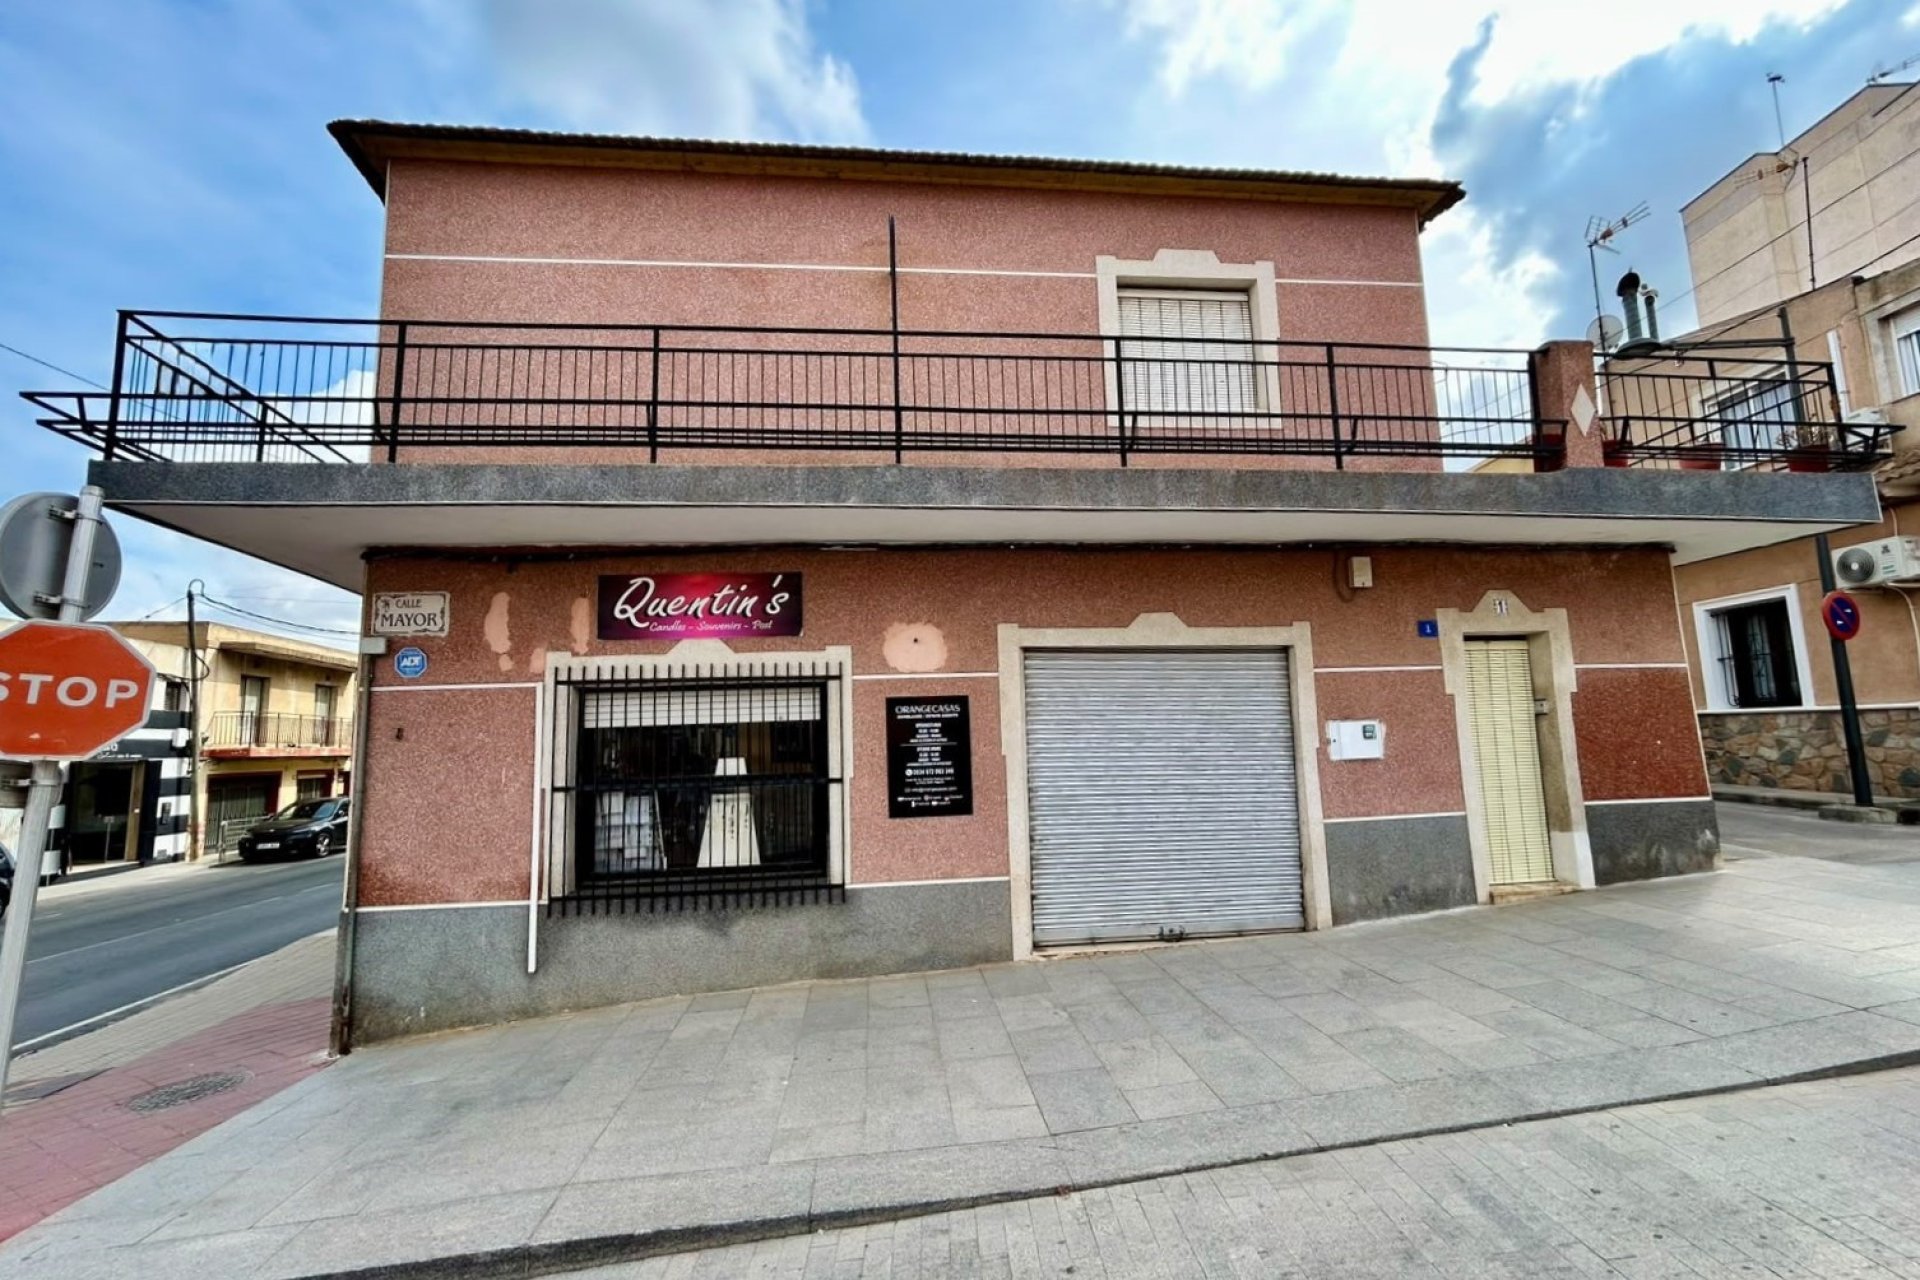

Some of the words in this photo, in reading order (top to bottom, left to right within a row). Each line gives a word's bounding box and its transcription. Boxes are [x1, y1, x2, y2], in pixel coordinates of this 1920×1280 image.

[395, 599, 422, 609] CALLE
[613, 574, 790, 628] Quentin's
[380, 612, 438, 627] MAYOR
[649, 620, 686, 632] Candles
[400, 656, 422, 667] ADT
